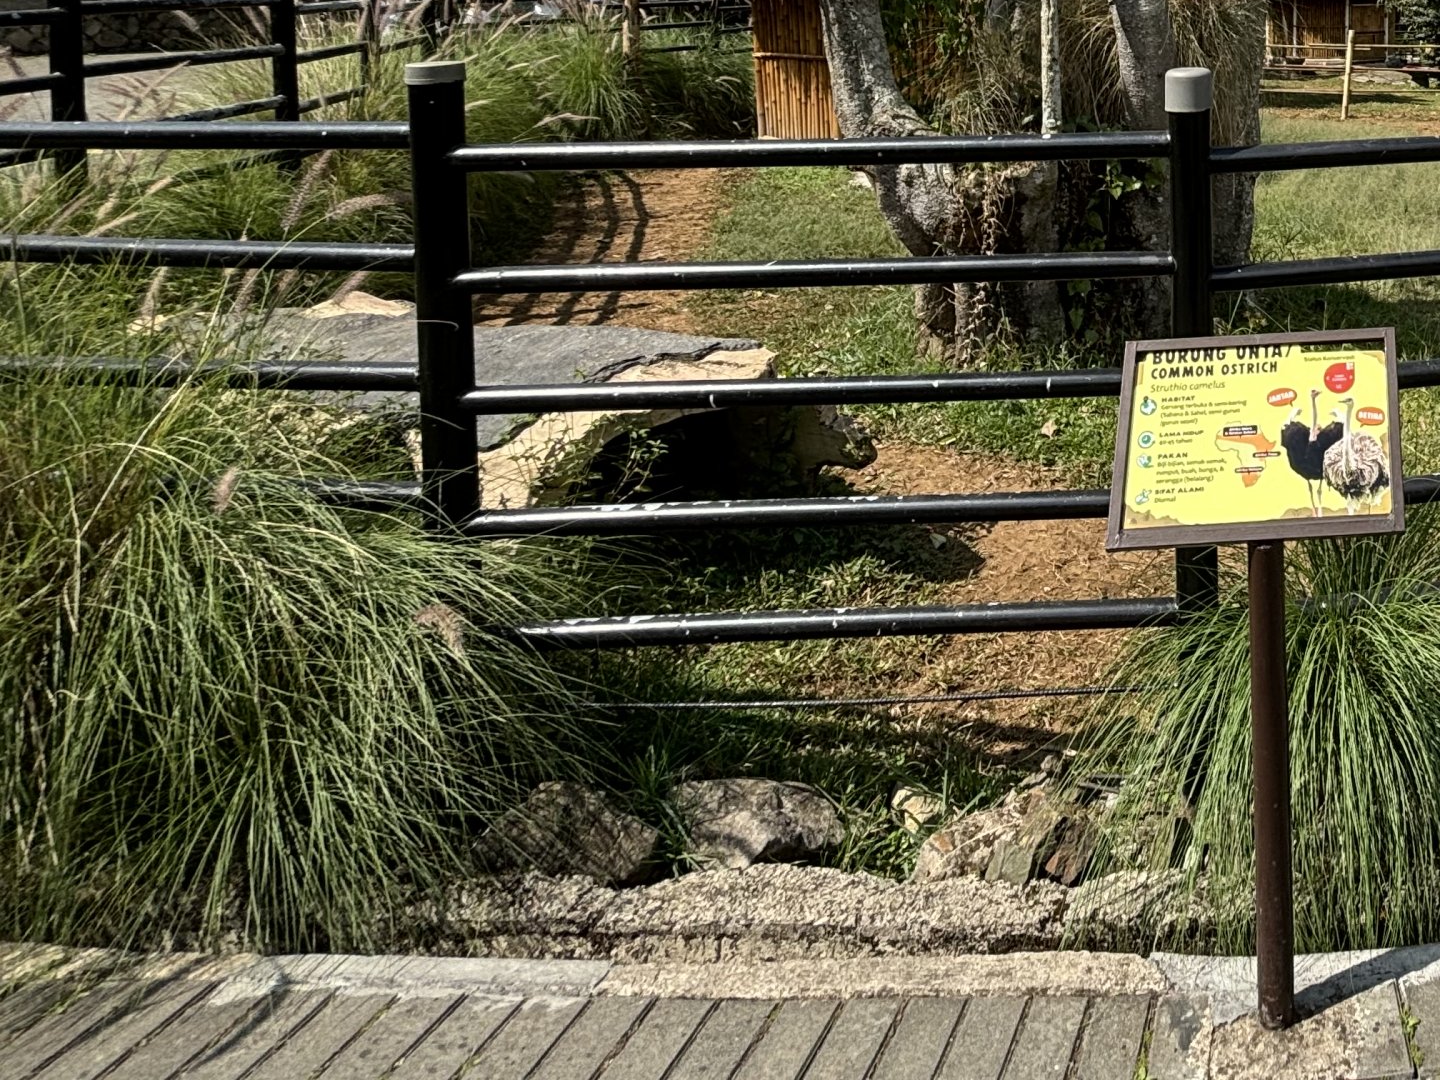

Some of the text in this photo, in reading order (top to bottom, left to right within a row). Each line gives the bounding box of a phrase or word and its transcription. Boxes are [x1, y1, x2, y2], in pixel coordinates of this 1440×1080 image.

[1153, 348, 1226, 365] BURUNG
[1151, 361, 1278, 380] COMMON OSTRICH
[1150, 380, 1226, 393] Struthio camelus
[1161, 395, 1196, 403] HABITAT
